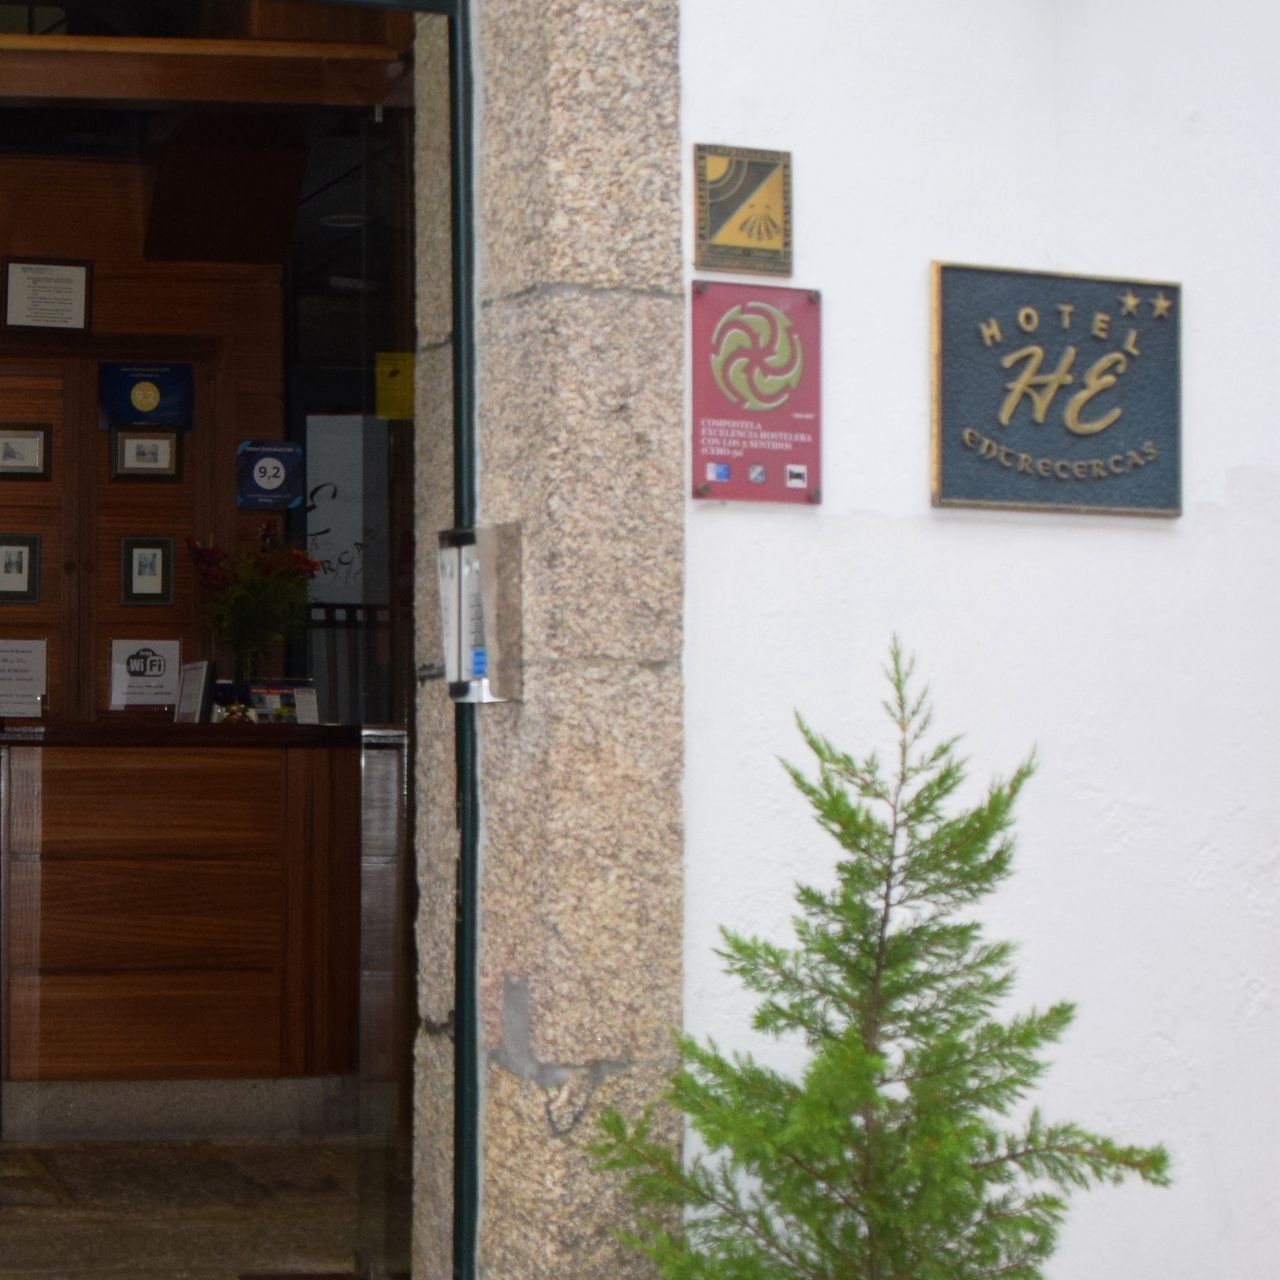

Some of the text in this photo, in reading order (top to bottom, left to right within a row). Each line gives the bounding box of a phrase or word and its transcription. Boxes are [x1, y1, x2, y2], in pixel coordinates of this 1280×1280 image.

[979, 304, 1140, 357] HOTEL
[998, 345, 1127, 435] HE
[701, 418, 762, 430] COMPOSTELA
[701, 427, 812, 442] EXCELENCIA HOSTELERA
[258, 466, 281, 480] 9,2
